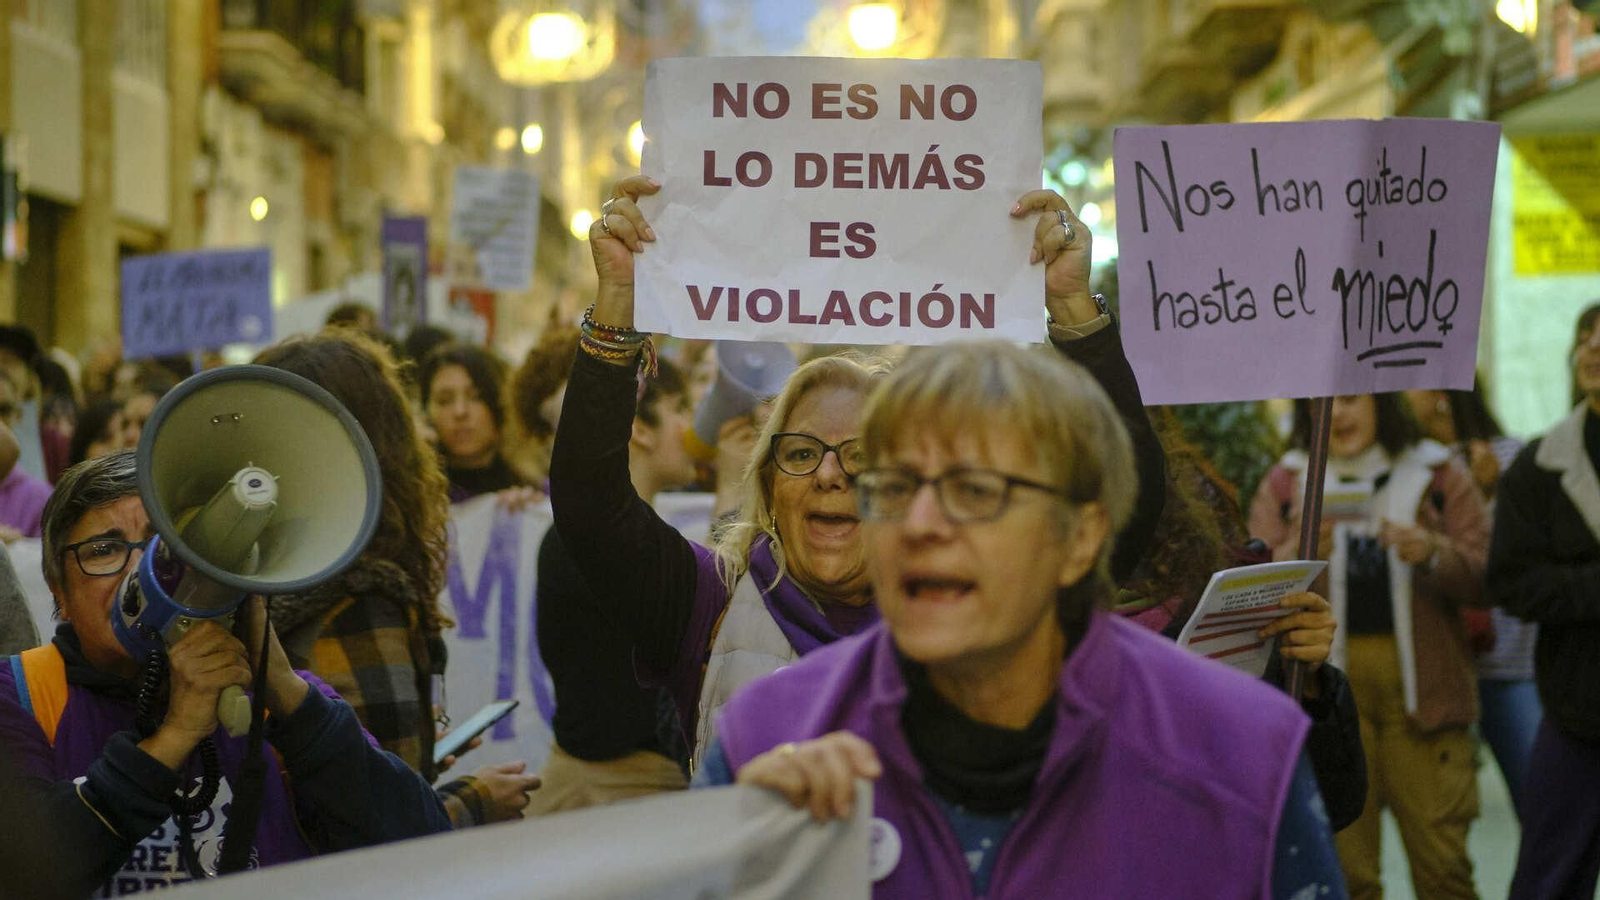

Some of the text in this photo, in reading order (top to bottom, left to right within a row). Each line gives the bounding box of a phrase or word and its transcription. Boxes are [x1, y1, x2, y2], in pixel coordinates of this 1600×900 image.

[712, 82, 978, 122] NO ES NO
[703, 144, 986, 191] LO DEMÁS
[1135, 140, 1236, 233] Nos
[1251, 147, 1324, 216] han
[1345, 146, 1448, 242] quitado
[809, 221, 878, 260] ES
[685, 283, 996, 330] VIOLACIÓN
[1147, 259, 1258, 331] hasta
[1272, 246, 1316, 320] el
[1331, 229, 1459, 350] miedo
